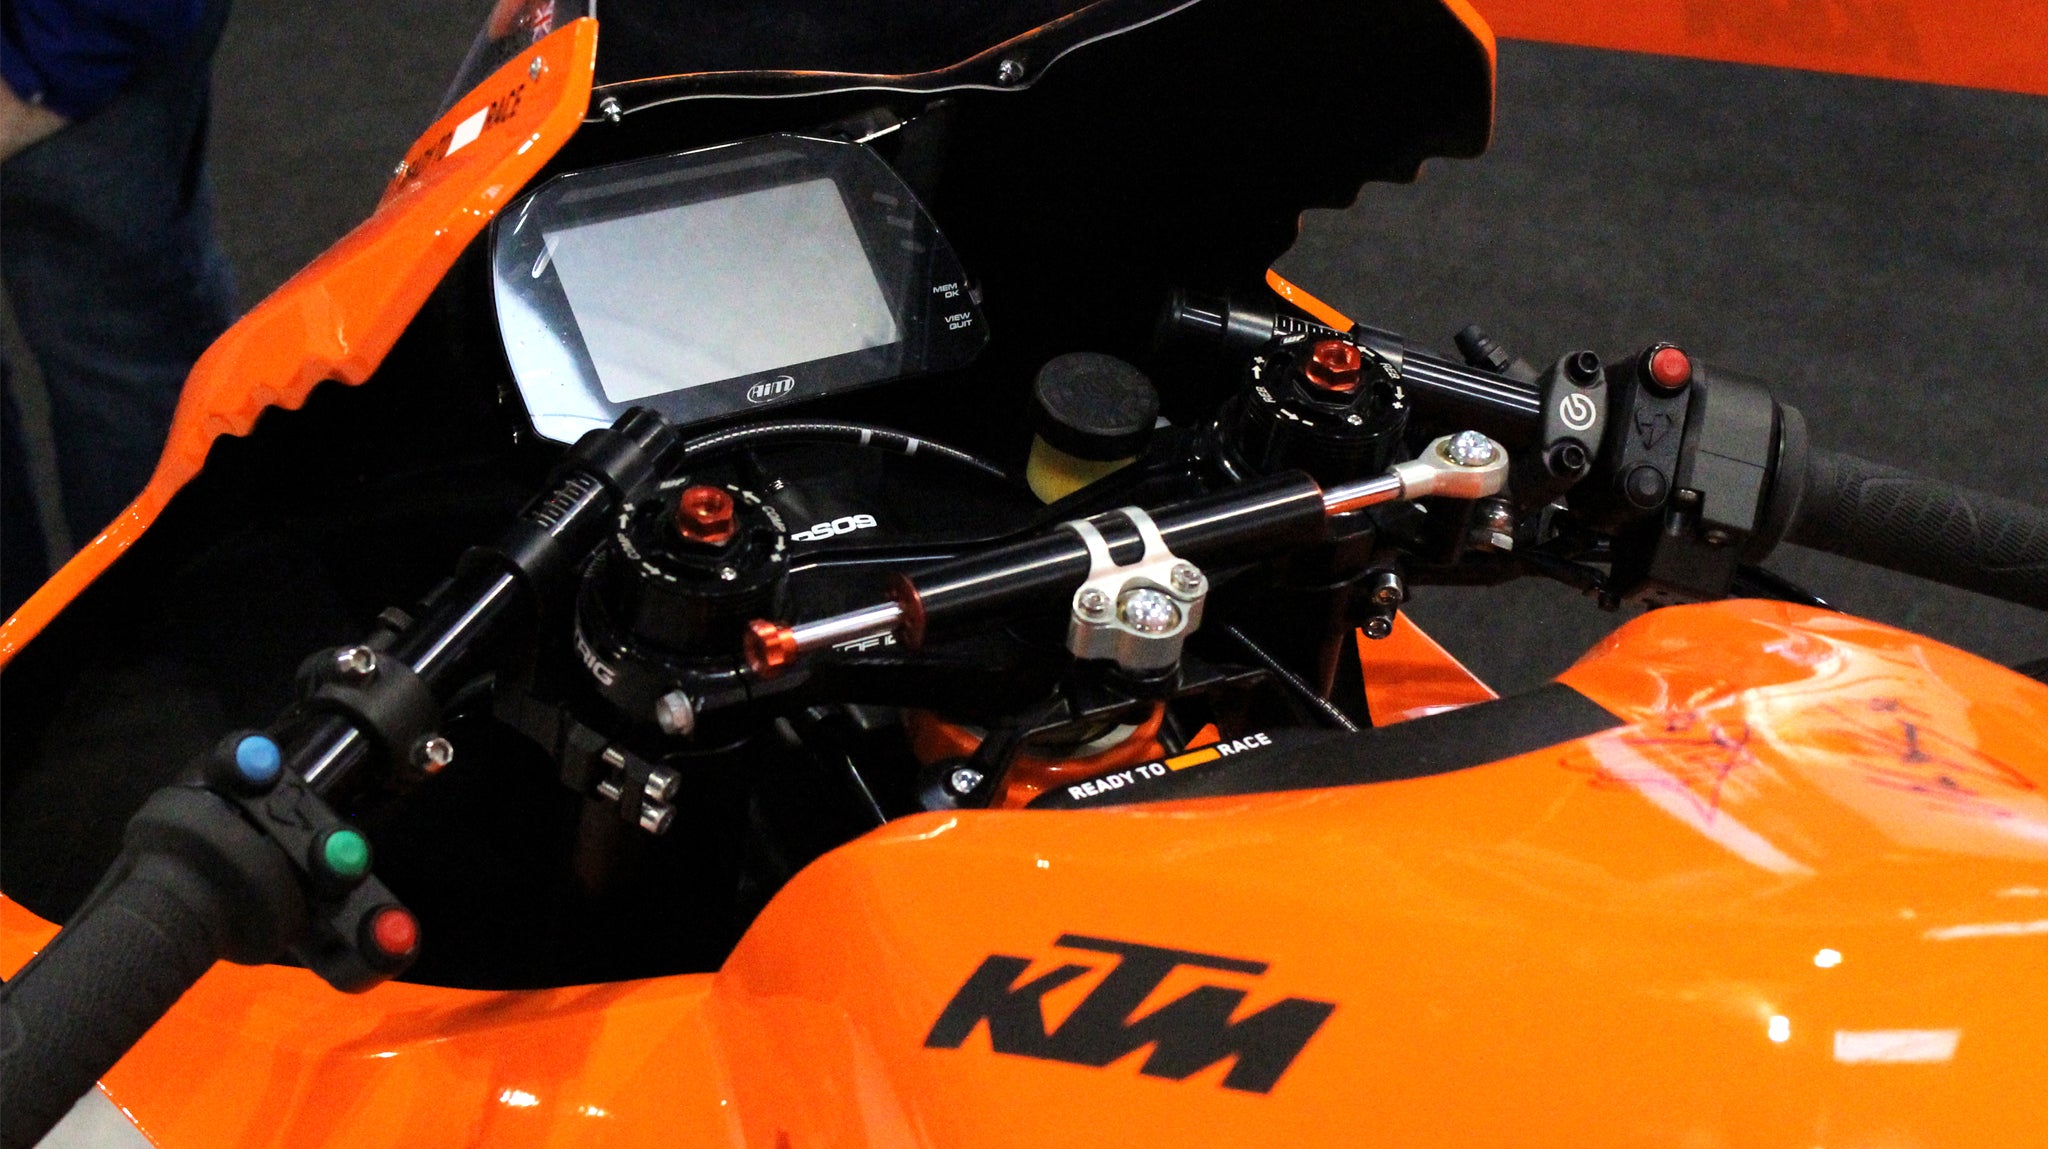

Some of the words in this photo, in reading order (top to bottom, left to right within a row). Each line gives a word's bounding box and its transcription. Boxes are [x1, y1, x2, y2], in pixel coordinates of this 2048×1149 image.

[932, 283, 958, 293] MEM
[945, 289, 959, 299] OK
[944, 312, 971, 323] VIEW
[949, 319, 973, 330] QUIT
[1068, 771, 1135, 800] READY
[1135, 763, 1166, 780] TO
[1217, 732, 1272, 757] RACE
[923, 933, 1337, 1094] KTM
